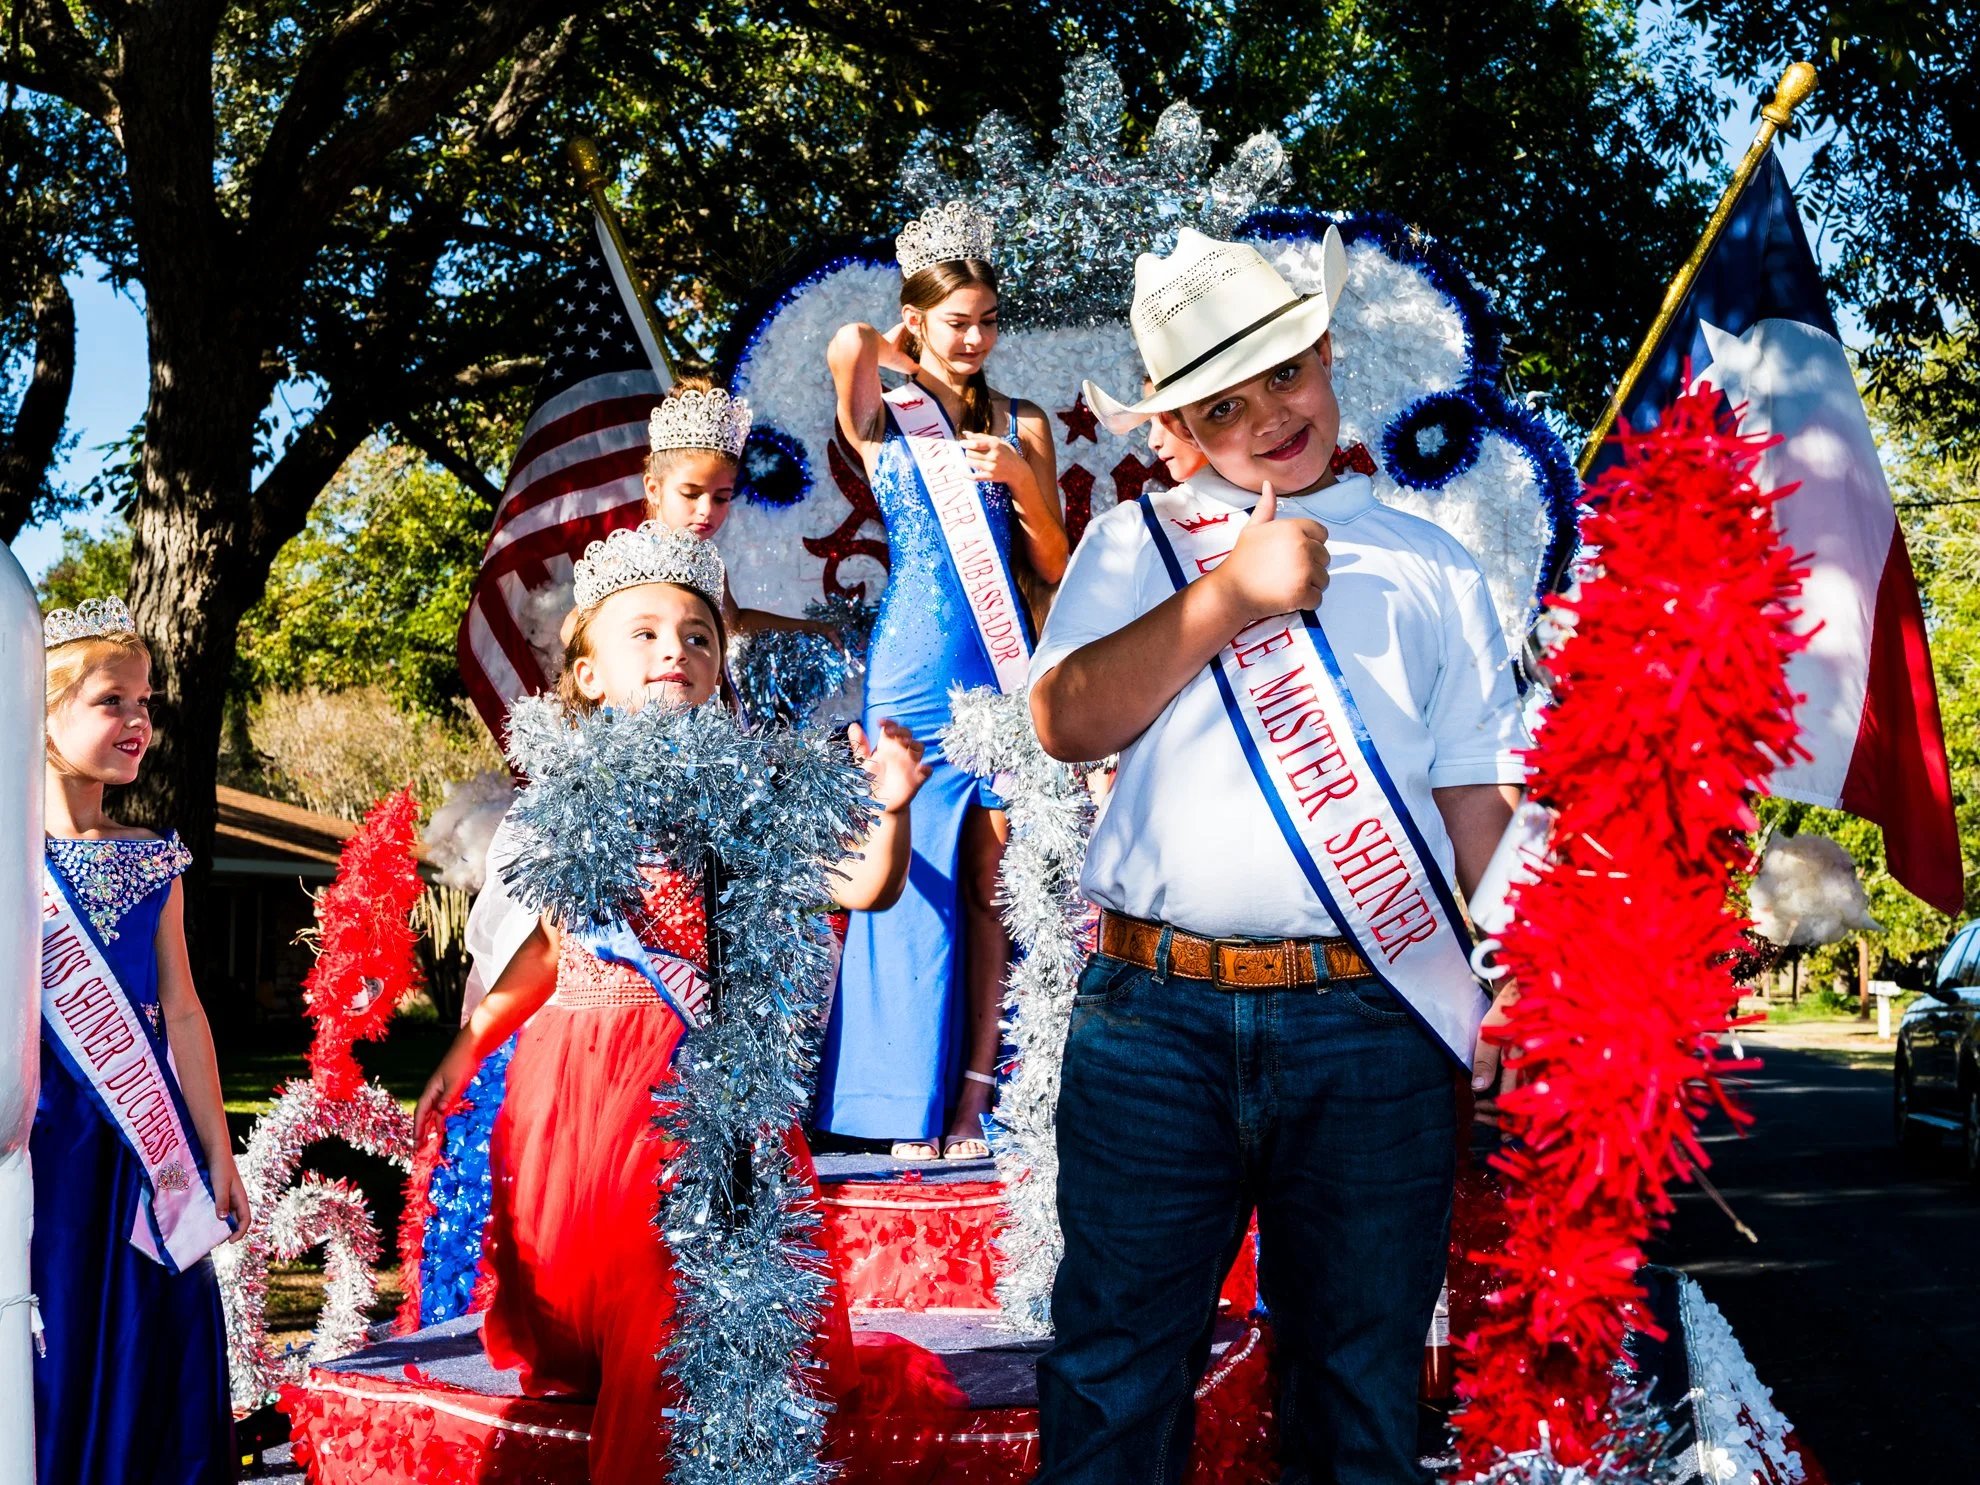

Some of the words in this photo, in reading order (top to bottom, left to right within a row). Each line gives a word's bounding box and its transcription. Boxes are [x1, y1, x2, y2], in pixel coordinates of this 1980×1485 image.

[909, 422, 949, 460] MISS
[927, 463, 977, 533] SHINER
[953, 539, 1020, 665] AMBASSADOR
[1248, 663, 1359, 822] MISTER
[1323, 817, 1438, 965] SHINER
[54, 976, 136, 1072] SHINER
[105, 1056, 180, 1166] DUCHESS
